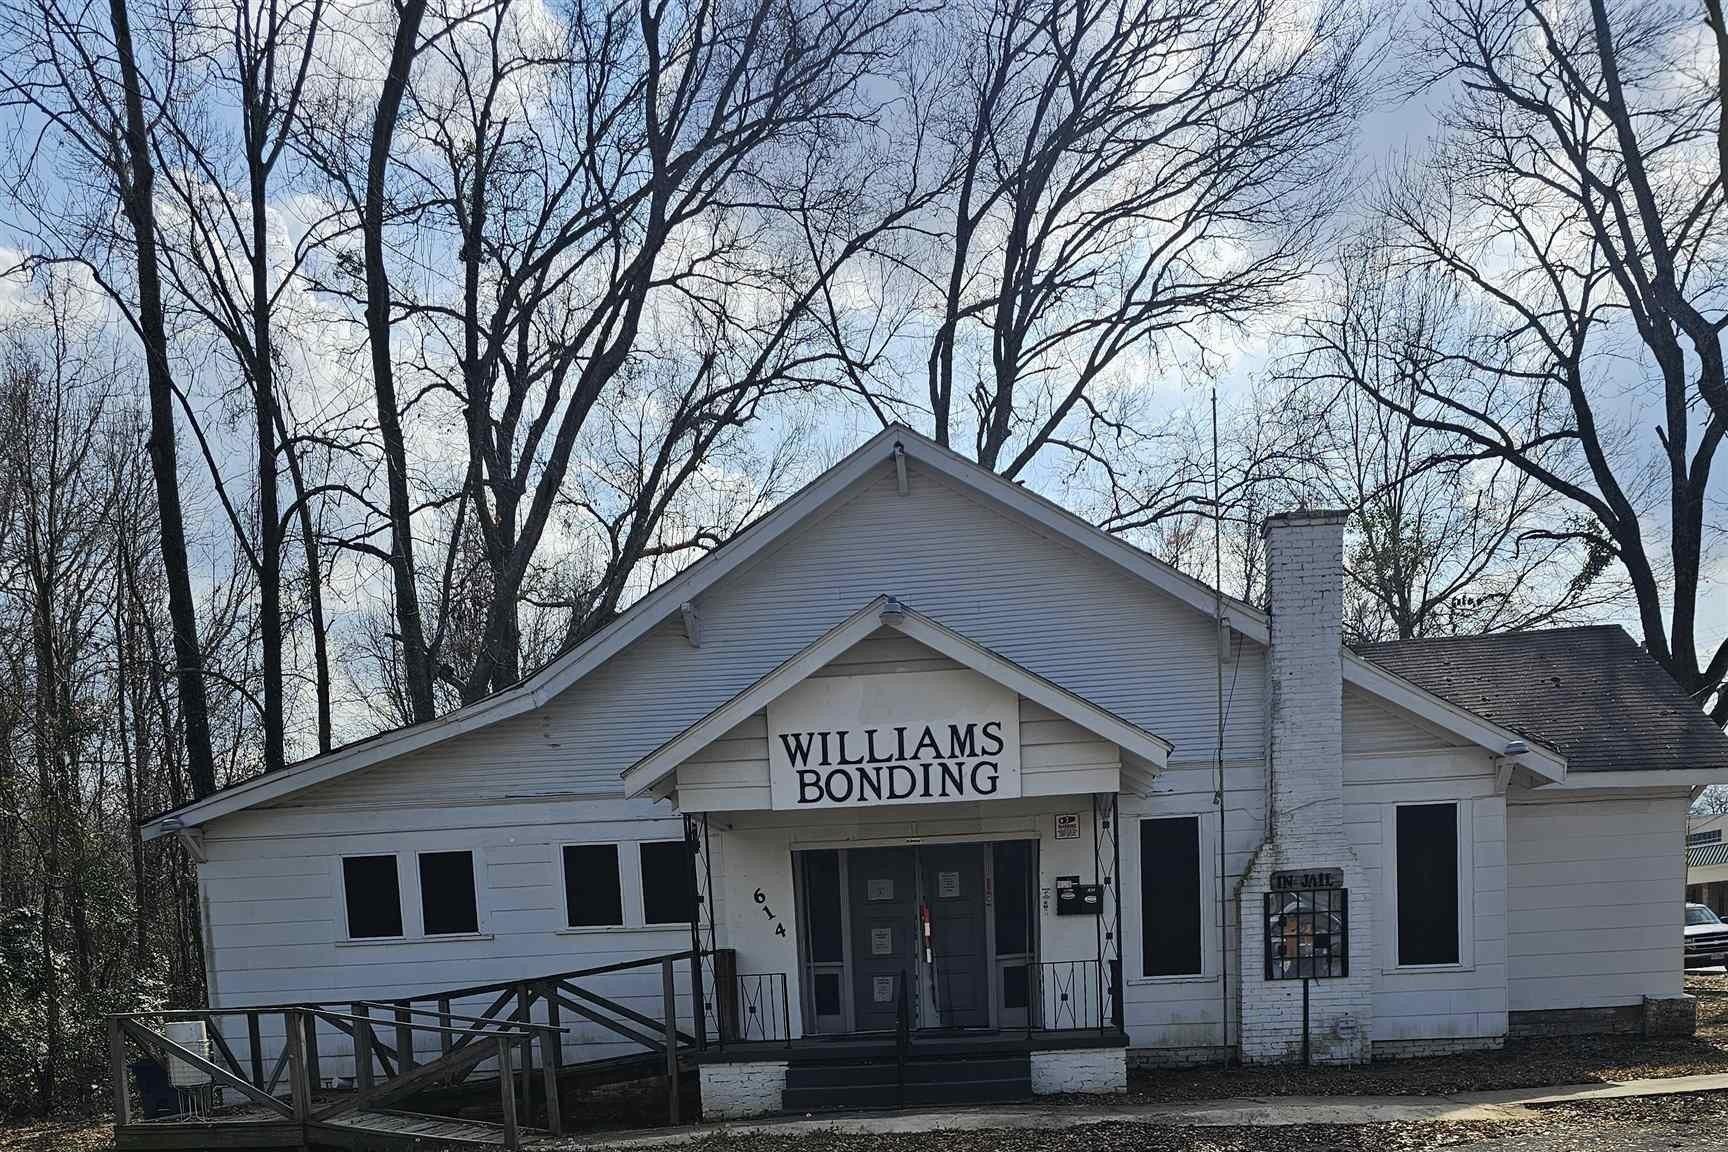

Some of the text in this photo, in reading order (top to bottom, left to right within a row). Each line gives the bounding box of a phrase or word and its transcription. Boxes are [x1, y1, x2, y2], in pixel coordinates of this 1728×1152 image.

[779, 721, 1004, 768] WILLIAMS
[796, 761, 999, 804] BONDING
[753, 887, 786, 938] 614
